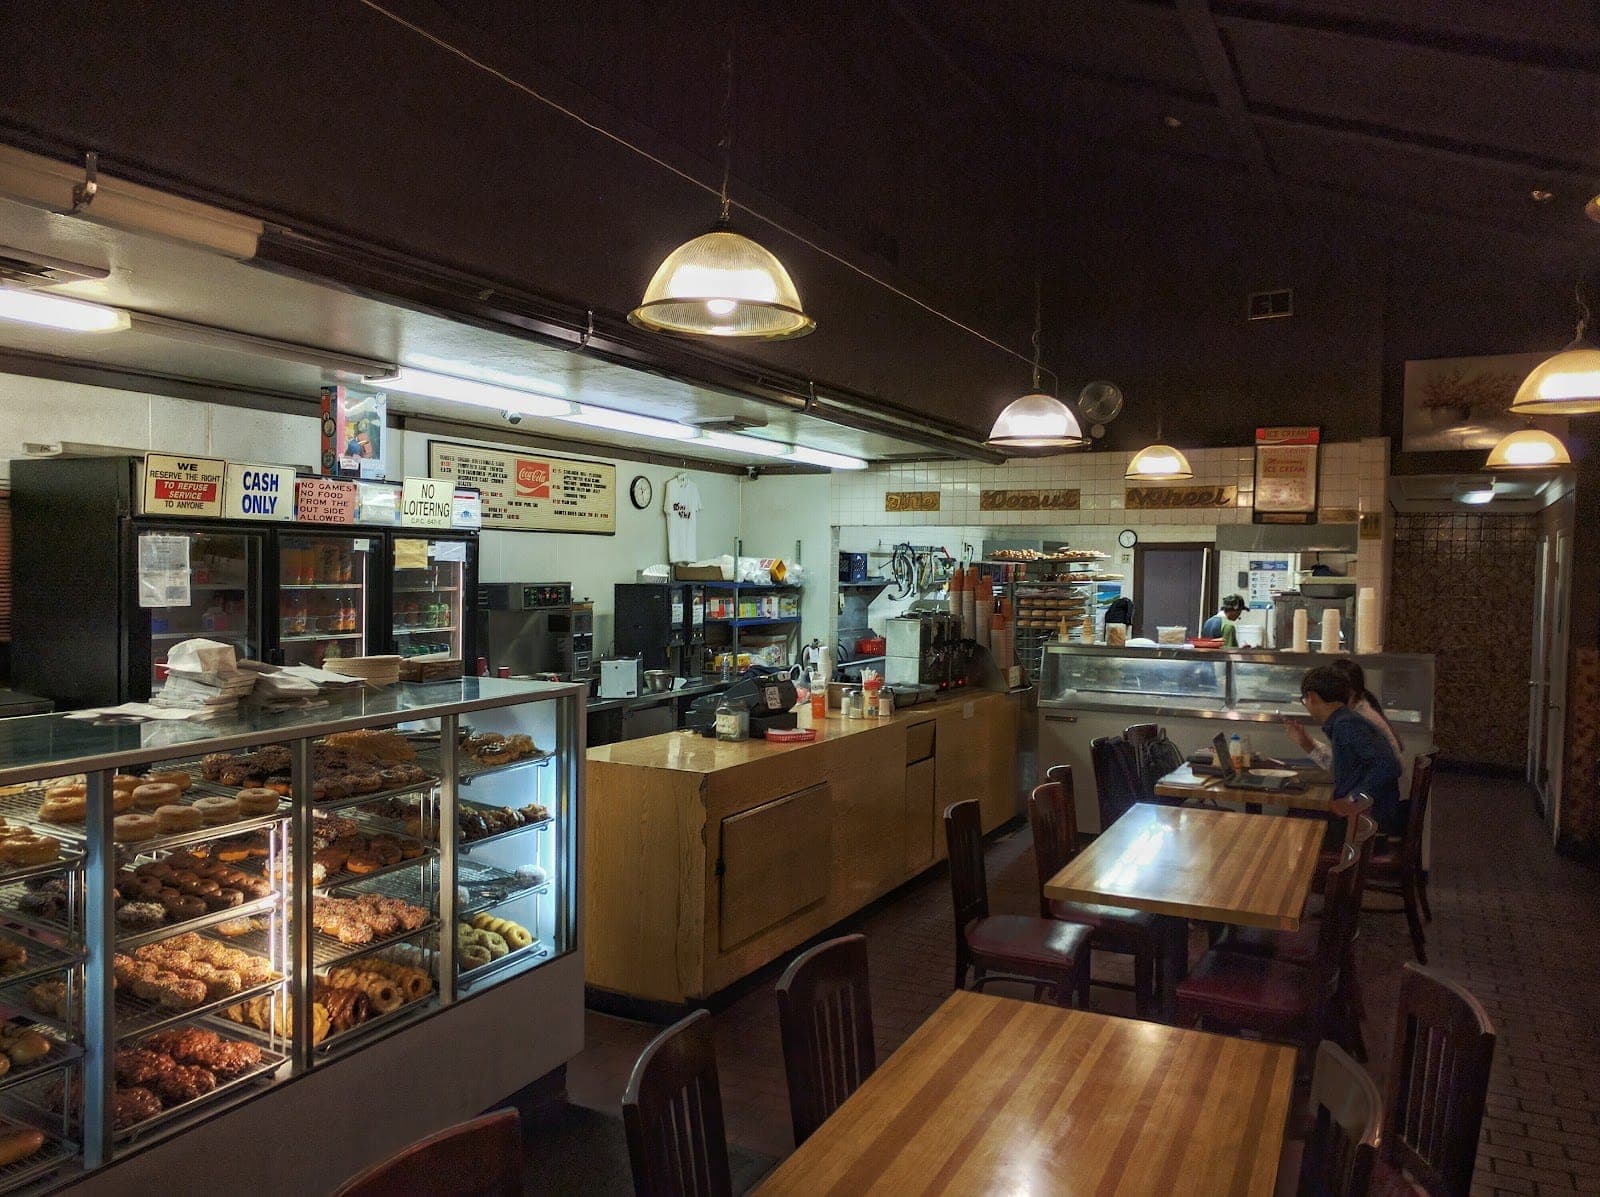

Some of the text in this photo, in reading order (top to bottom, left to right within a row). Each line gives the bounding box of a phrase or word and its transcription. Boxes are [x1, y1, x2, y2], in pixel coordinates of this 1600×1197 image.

[177, 462, 198, 471] WE
[150, 470, 221, 482] RESERVE THE RIGHT
[243, 471, 279, 492] CASH
[177, 482, 208, 491] REFUSE
[318, 483, 352, 492] GAMES
[168, 490, 202, 499] SERVICE
[318, 491, 343, 499] FOOD
[421, 484, 435, 499] NO
[165, 500, 204, 509] TO ANYONE
[242, 494, 278, 514] ONLY
[300, 498, 327, 506] FROM
[403, 500, 450, 517] LOITERING
[299, 514, 345, 523] ALLOWED
